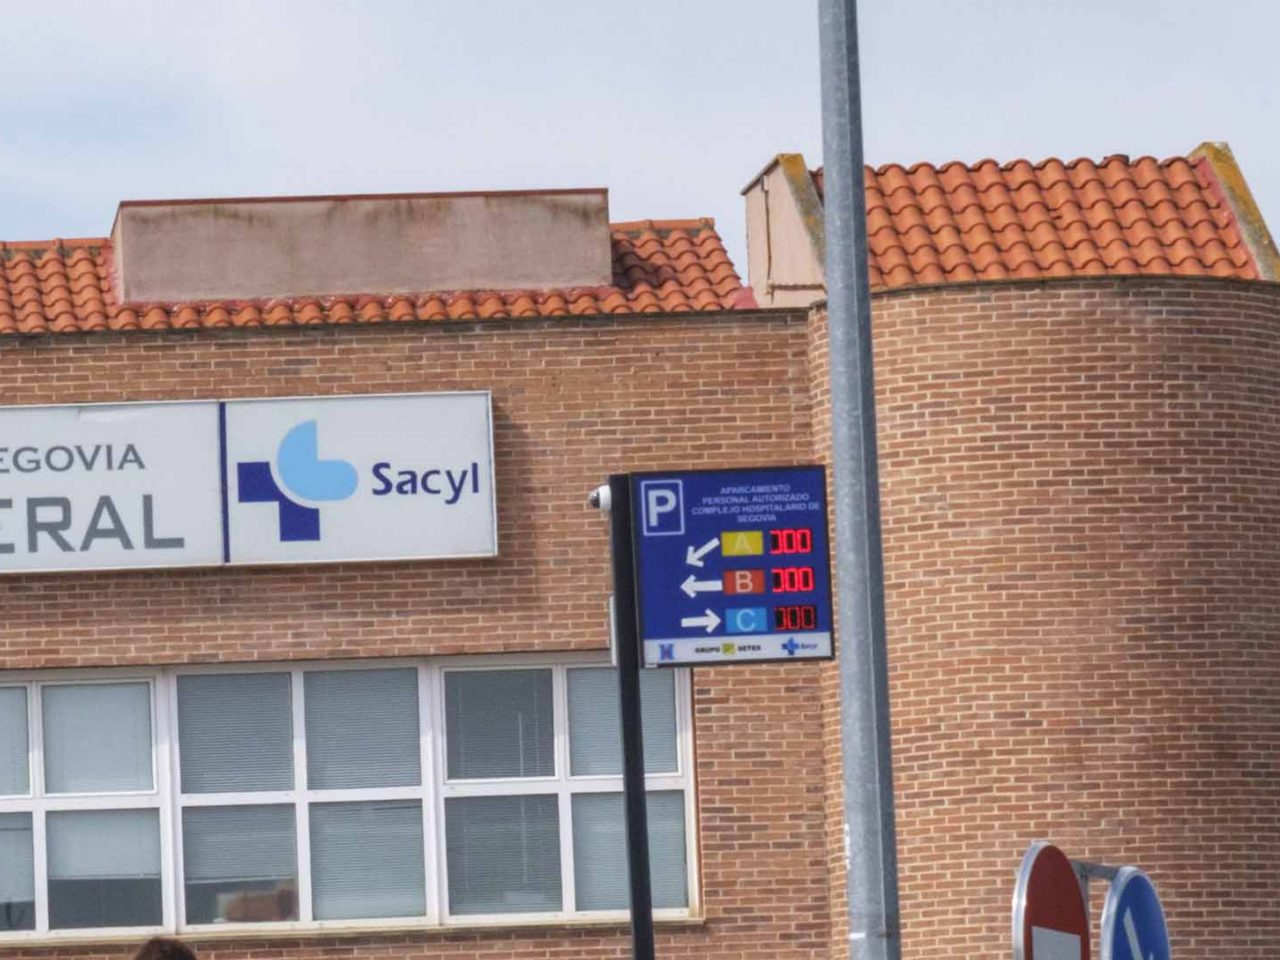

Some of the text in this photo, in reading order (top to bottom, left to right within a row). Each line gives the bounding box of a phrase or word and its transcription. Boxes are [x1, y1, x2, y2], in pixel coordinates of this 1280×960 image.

[370, 461, 479, 505] Sacyl
[720, 484, 791, 494] APARCAMIENTO
[648, 489, 677, 527] P
[691, 501, 820, 515] COMPLEJO HOSPITALARIO DE
[702, 493, 810, 505] PERSONAL AUTORIZADO
[737, 514, 777, 523] SEGOVIA
[734, 532, 753, 554] A
[735, 570, 754, 593] B
[736, 608, 756, 631] C
